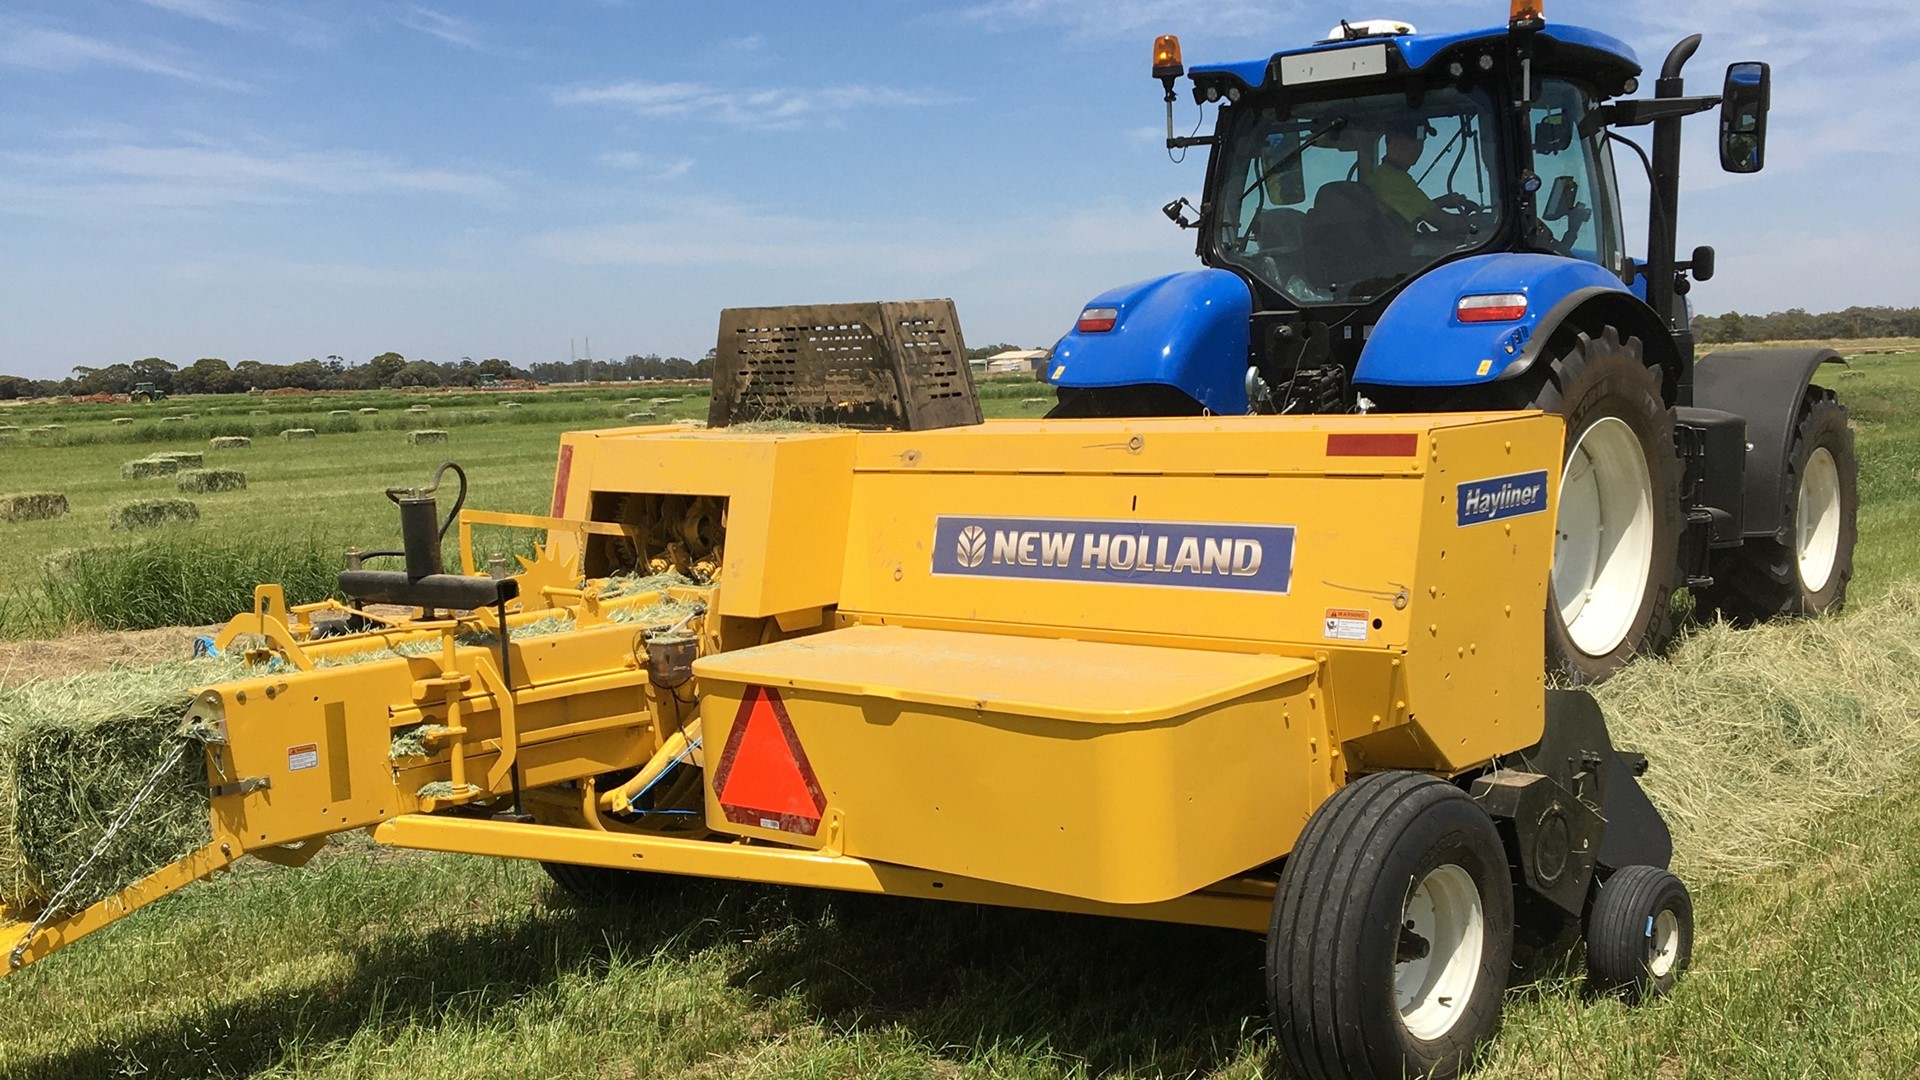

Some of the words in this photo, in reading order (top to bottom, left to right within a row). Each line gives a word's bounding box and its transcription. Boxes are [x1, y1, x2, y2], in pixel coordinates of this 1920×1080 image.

[1465, 483, 1540, 518] Hayliner
[992, 530, 1075, 567] NEW
[1081, 533, 1262, 576] HOLLAND
